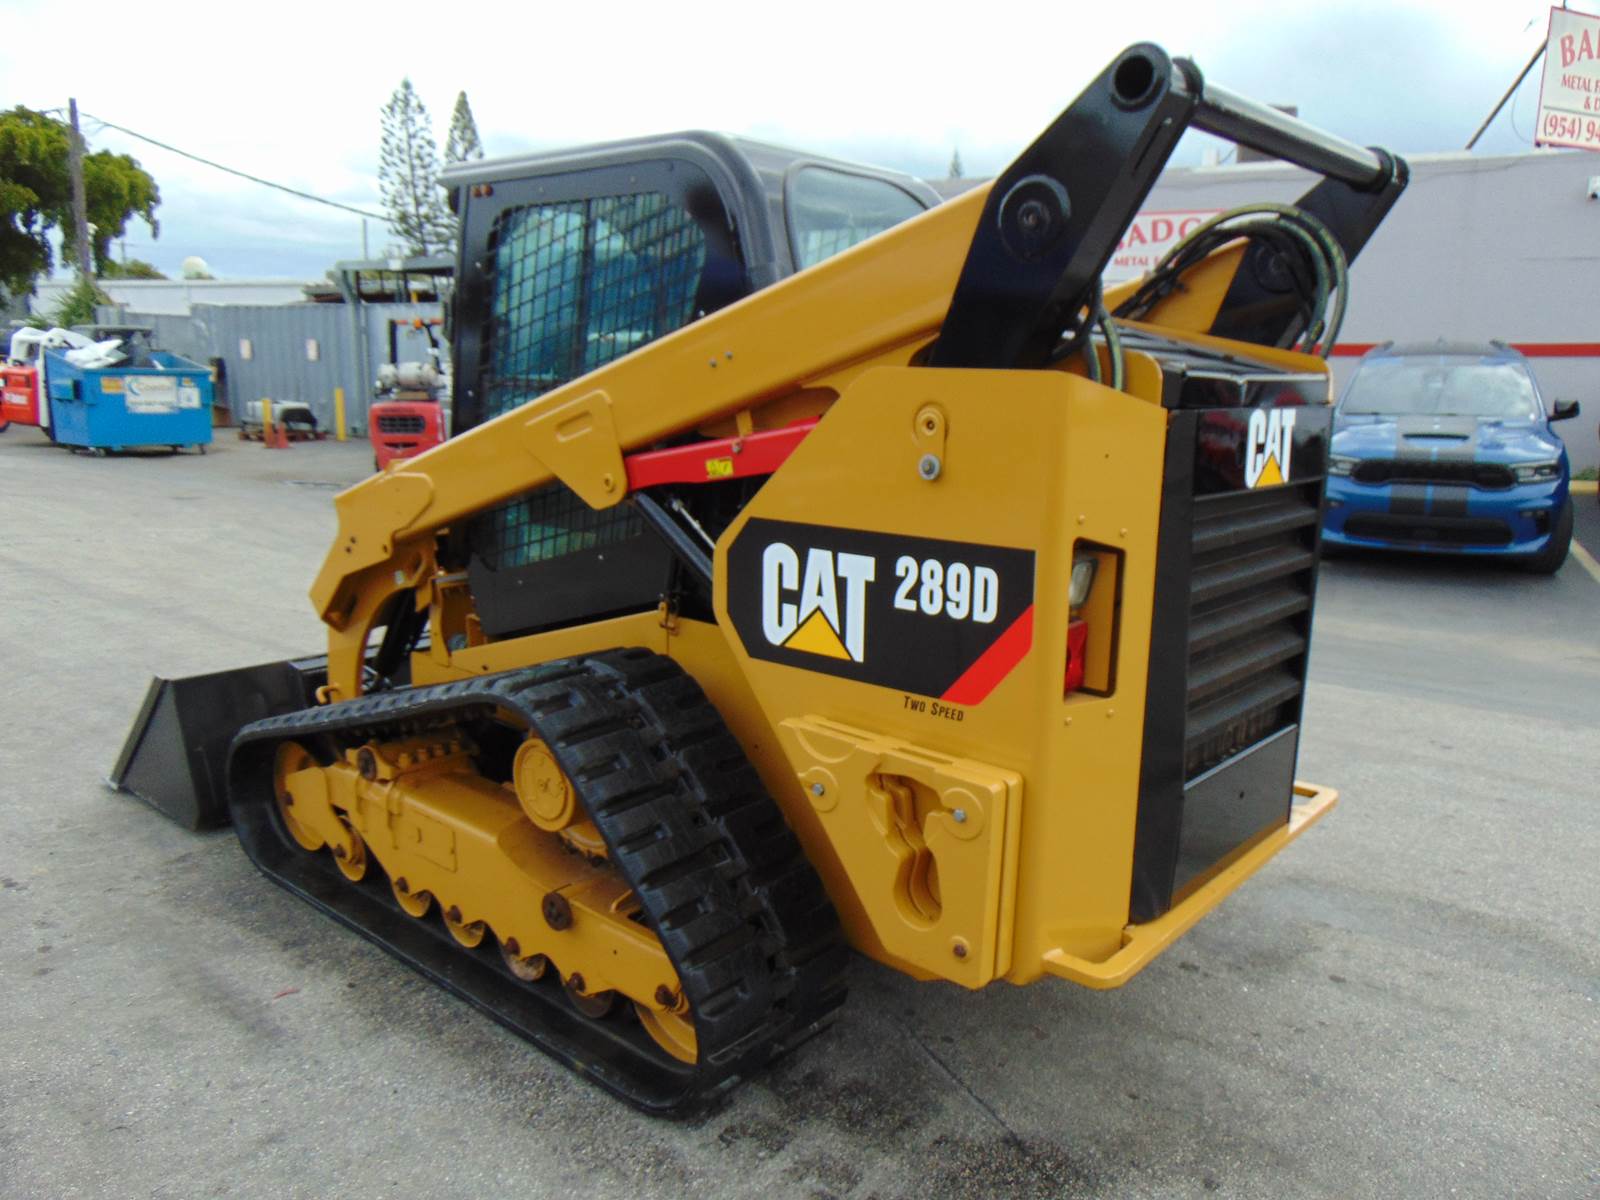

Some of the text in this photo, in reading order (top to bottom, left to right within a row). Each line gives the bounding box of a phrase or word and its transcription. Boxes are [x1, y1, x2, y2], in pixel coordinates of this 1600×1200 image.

[1560, 28, 1600, 68] BA
[1561, 73, 1591, 93] METAL
[1543, 112, 1582, 140] (954)
[1245, 408, 1297, 490] CAT
[762, 542, 999, 664] CAT 289D
